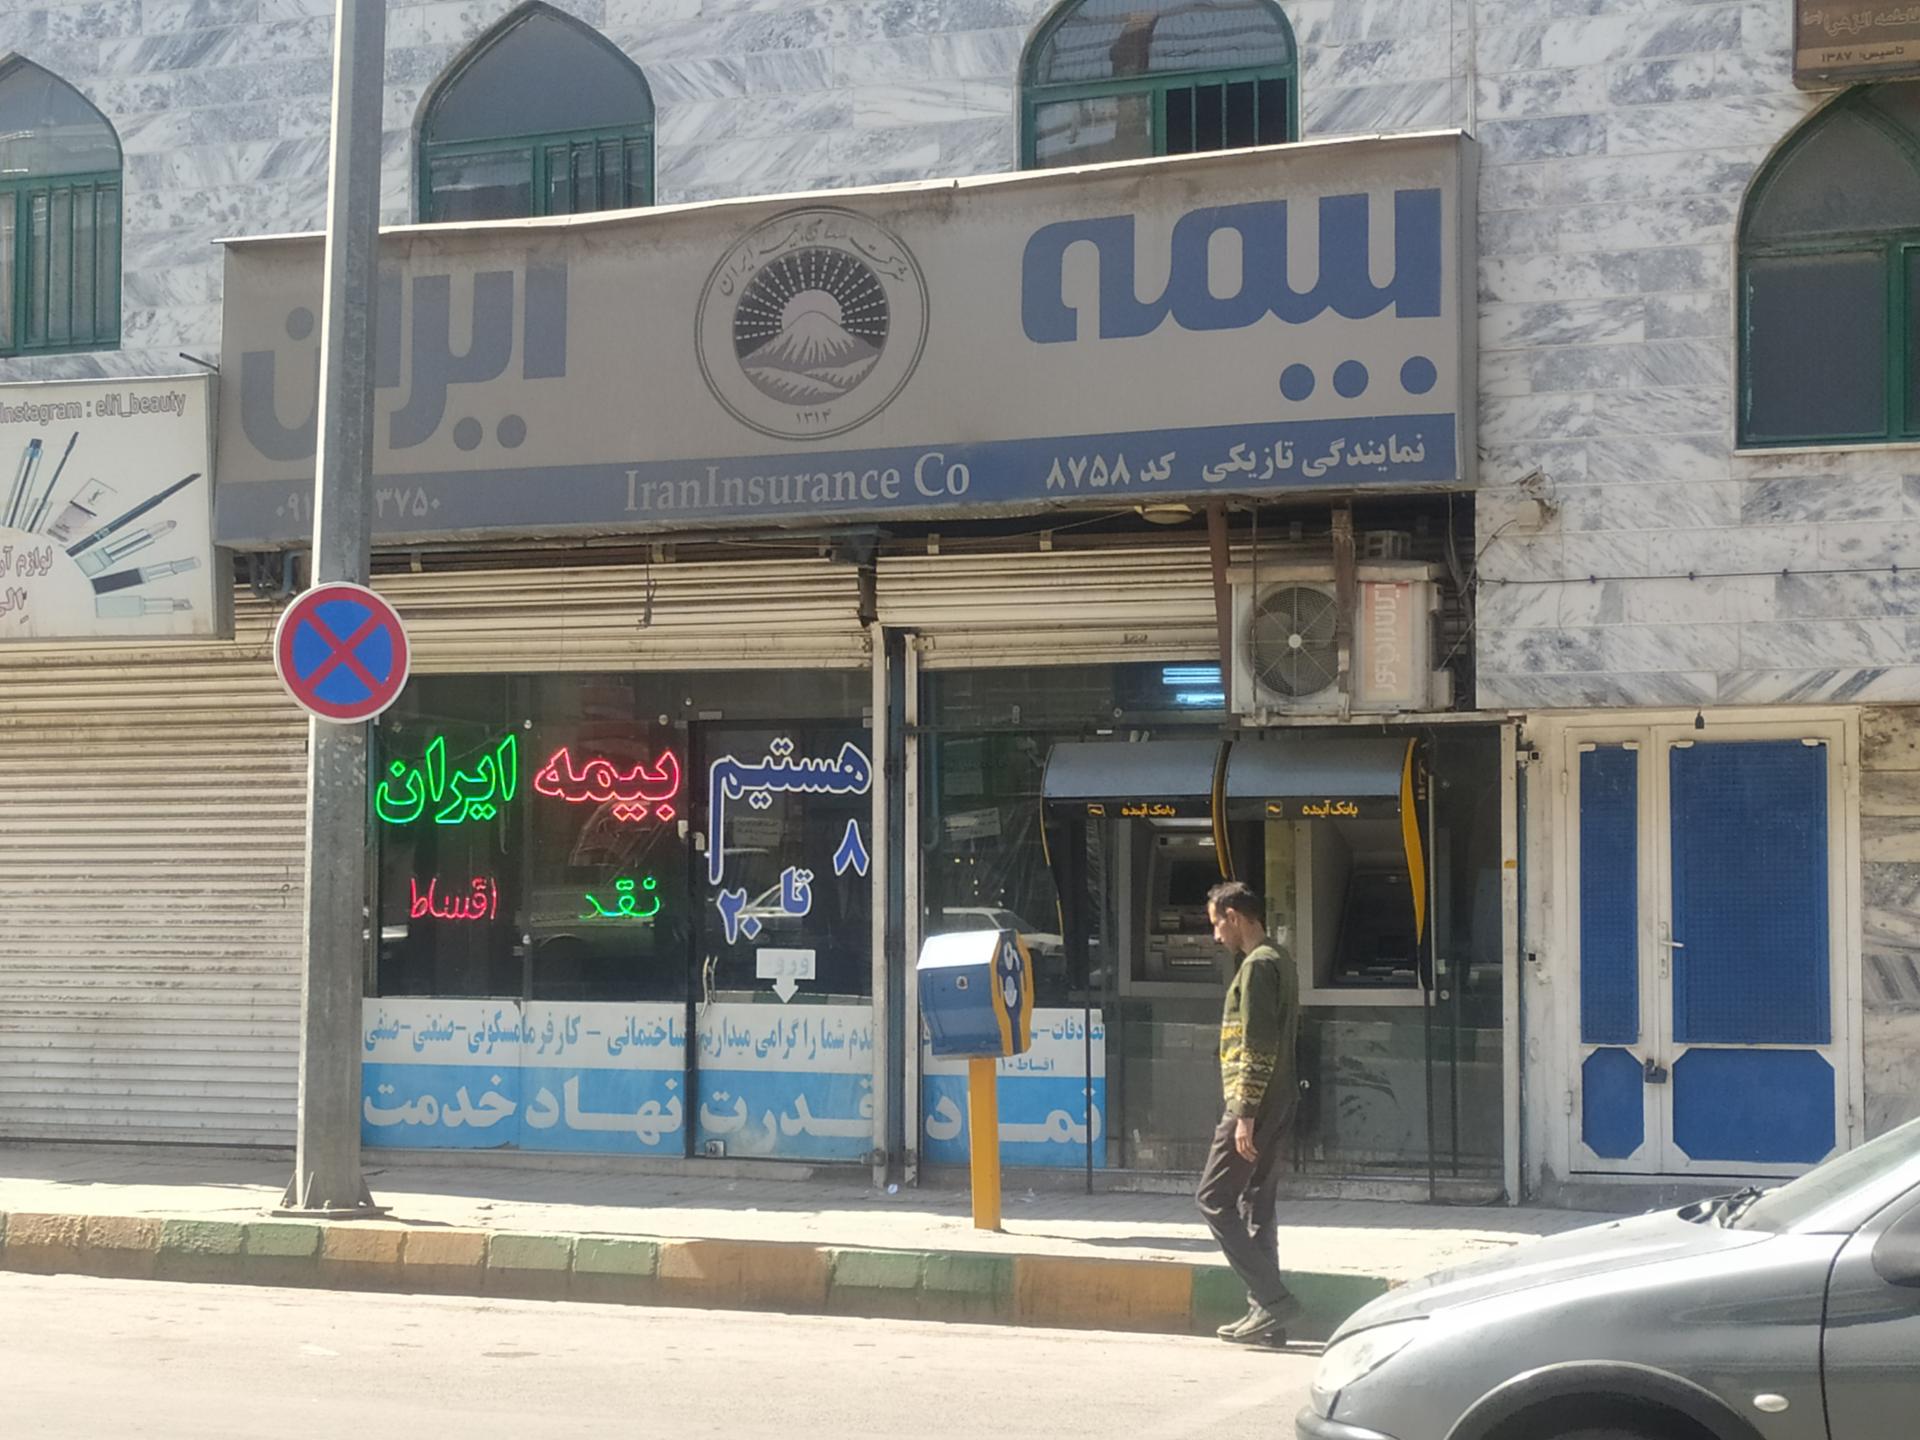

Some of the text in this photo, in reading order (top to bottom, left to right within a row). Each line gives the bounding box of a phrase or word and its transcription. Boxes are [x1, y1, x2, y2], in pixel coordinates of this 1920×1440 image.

[1821, 51, 1853, 62] ۱۳۸۷
[1021, 187, 1442, 402] بیمه
[914, 452, 971, 497] Co
[1046, 433, 1426, 490] نمایندگی تازیکی کد ۸۷۵۸
[16, 545, 53, 577] لوازم
[376, 734, 680, 824] بیمه ایران
[709, 737, 872, 885] هستیم
[1330, 800, 1359, 816] بانک
[832, 817, 870, 877] ۸
[409, 876, 661, 921] نقد اقساط
[780, 866, 815, 917] تا
[716, 887, 763, 946] ۲۰
[755, 1016, 799, 1059] گرامی
[804, 1017, 816, 1060] را
[820, 1016, 845, 1049] شما
[1016, 1057, 1055, 1071] اقساط
[363, 1074, 517, 1128] خدمت
[526, 1075, 683, 1145] نهاد
